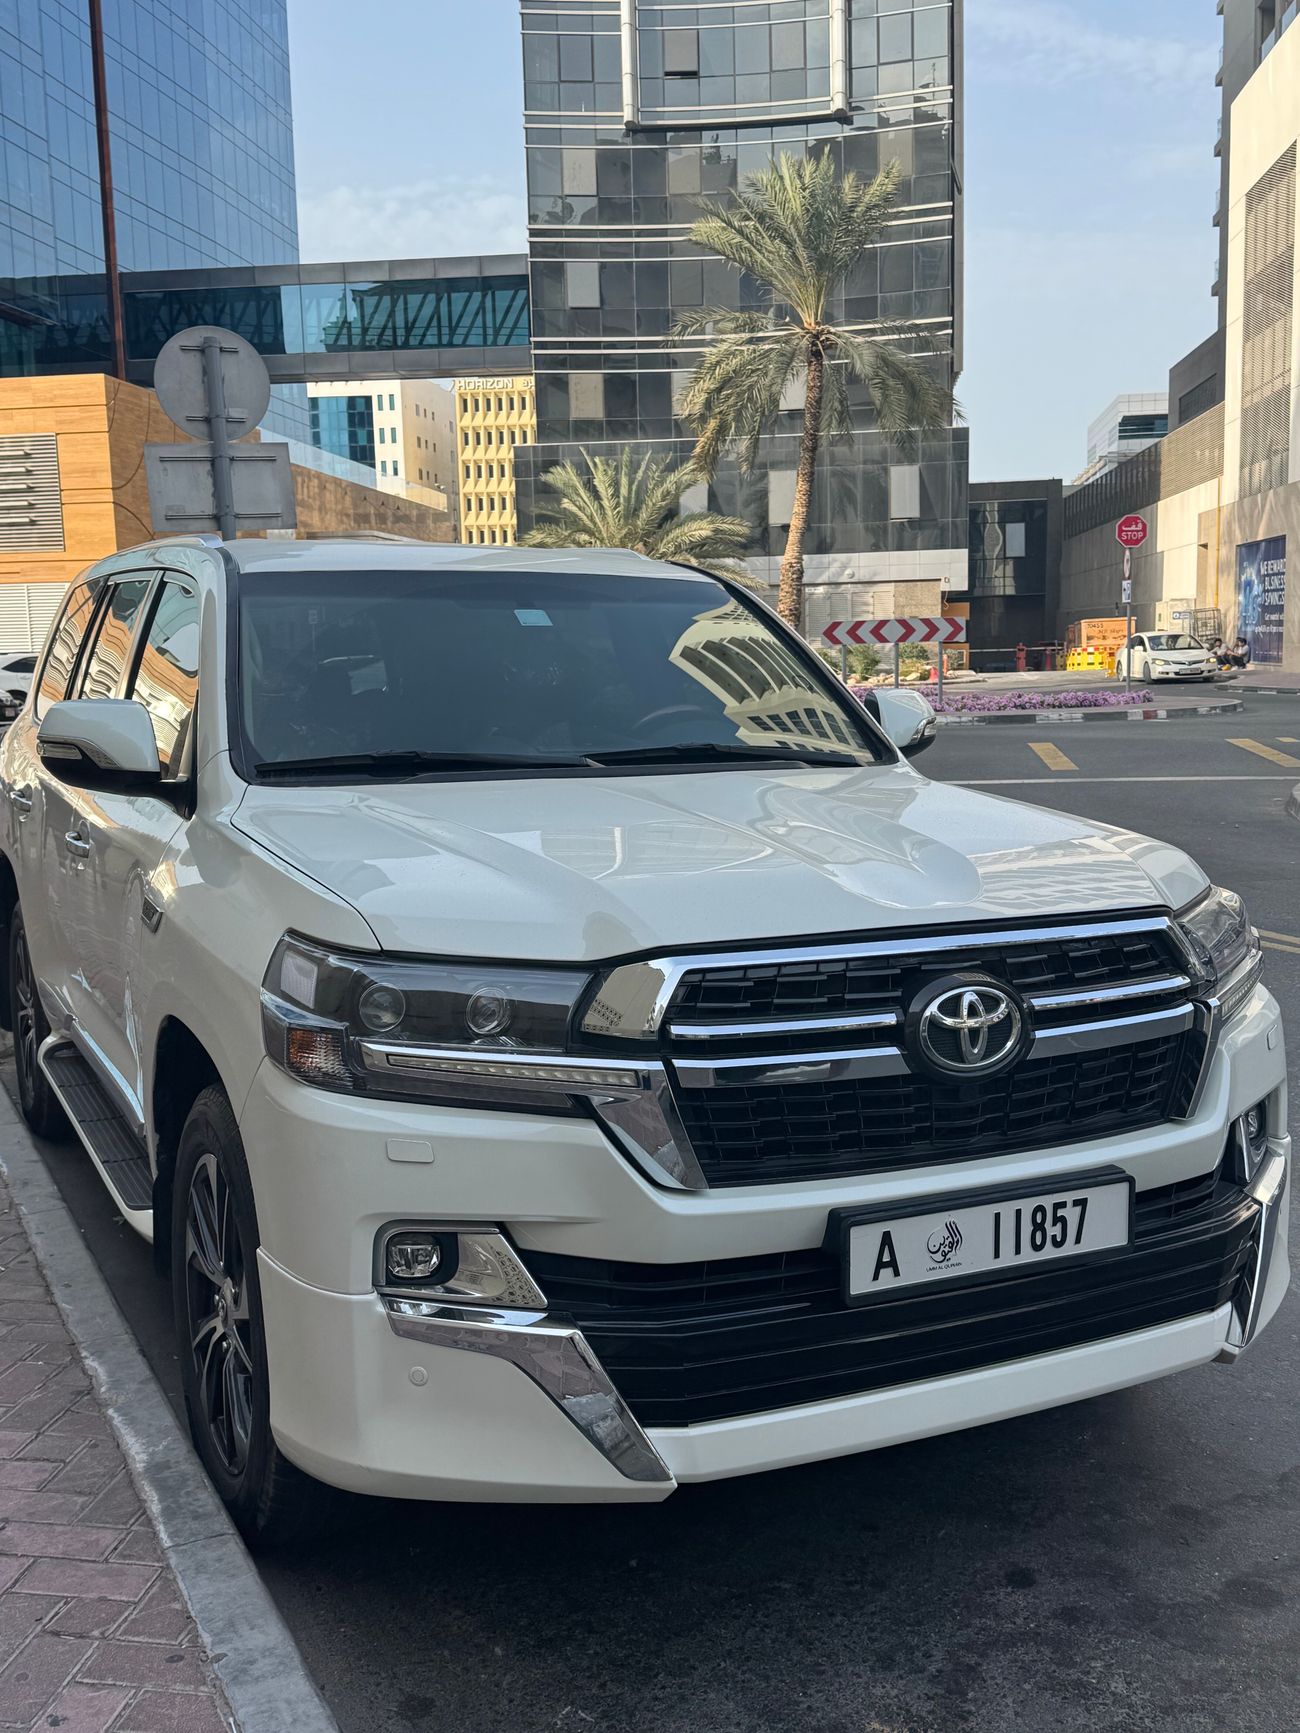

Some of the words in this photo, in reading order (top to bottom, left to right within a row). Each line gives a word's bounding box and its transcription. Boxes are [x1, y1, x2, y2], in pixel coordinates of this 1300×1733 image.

[457, 378, 514, 390] HORIZON
[1122, 520, 1142, 530] قف
[1121, 532, 1143, 540] STOP
[1260, 560, 1267, 575] WE
[1264, 591, 1285, 606] SAVINGS
[872, 1229, 901, 1281] A
[993, 1197, 1089, 1260] 11857
